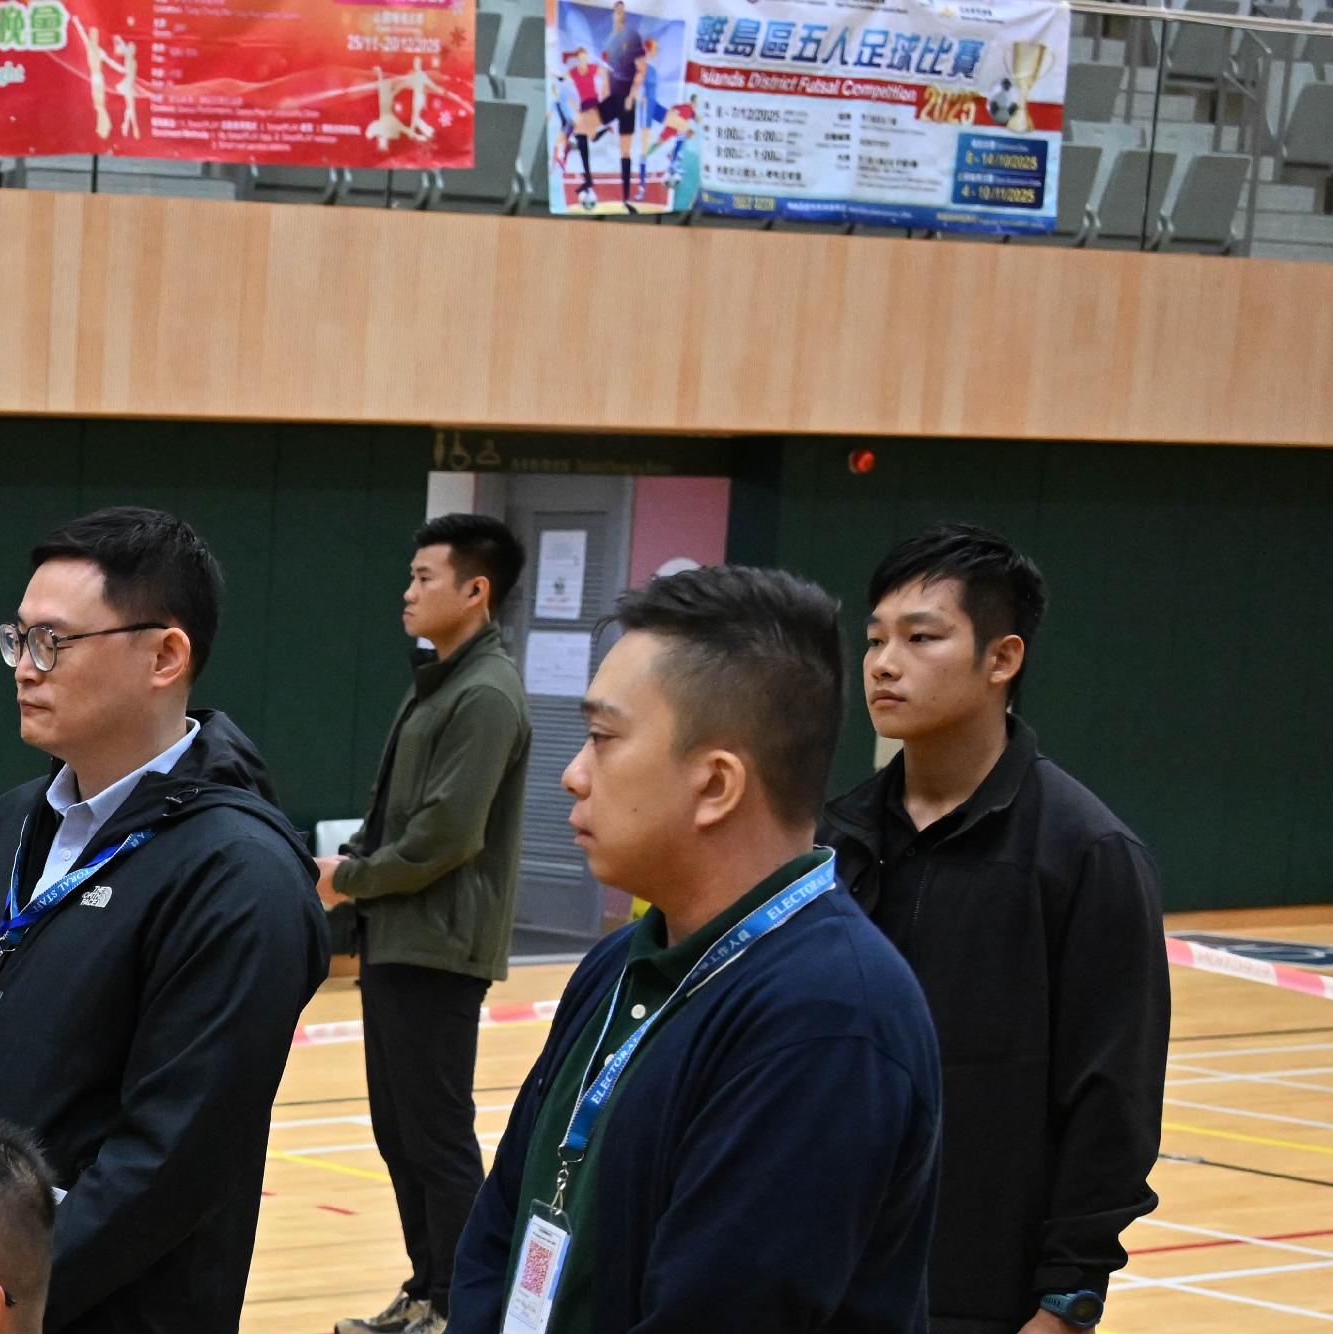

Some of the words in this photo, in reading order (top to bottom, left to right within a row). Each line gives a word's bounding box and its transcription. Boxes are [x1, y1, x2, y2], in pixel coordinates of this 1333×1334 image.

[695, 15, 984, 79] 離島區五人足球比賽
[700, 69, 745, 89] Islands
[748, 75, 796, 94] District
[797, 77, 840, 95] Futsal
[919, 86, 977, 125] 2025
